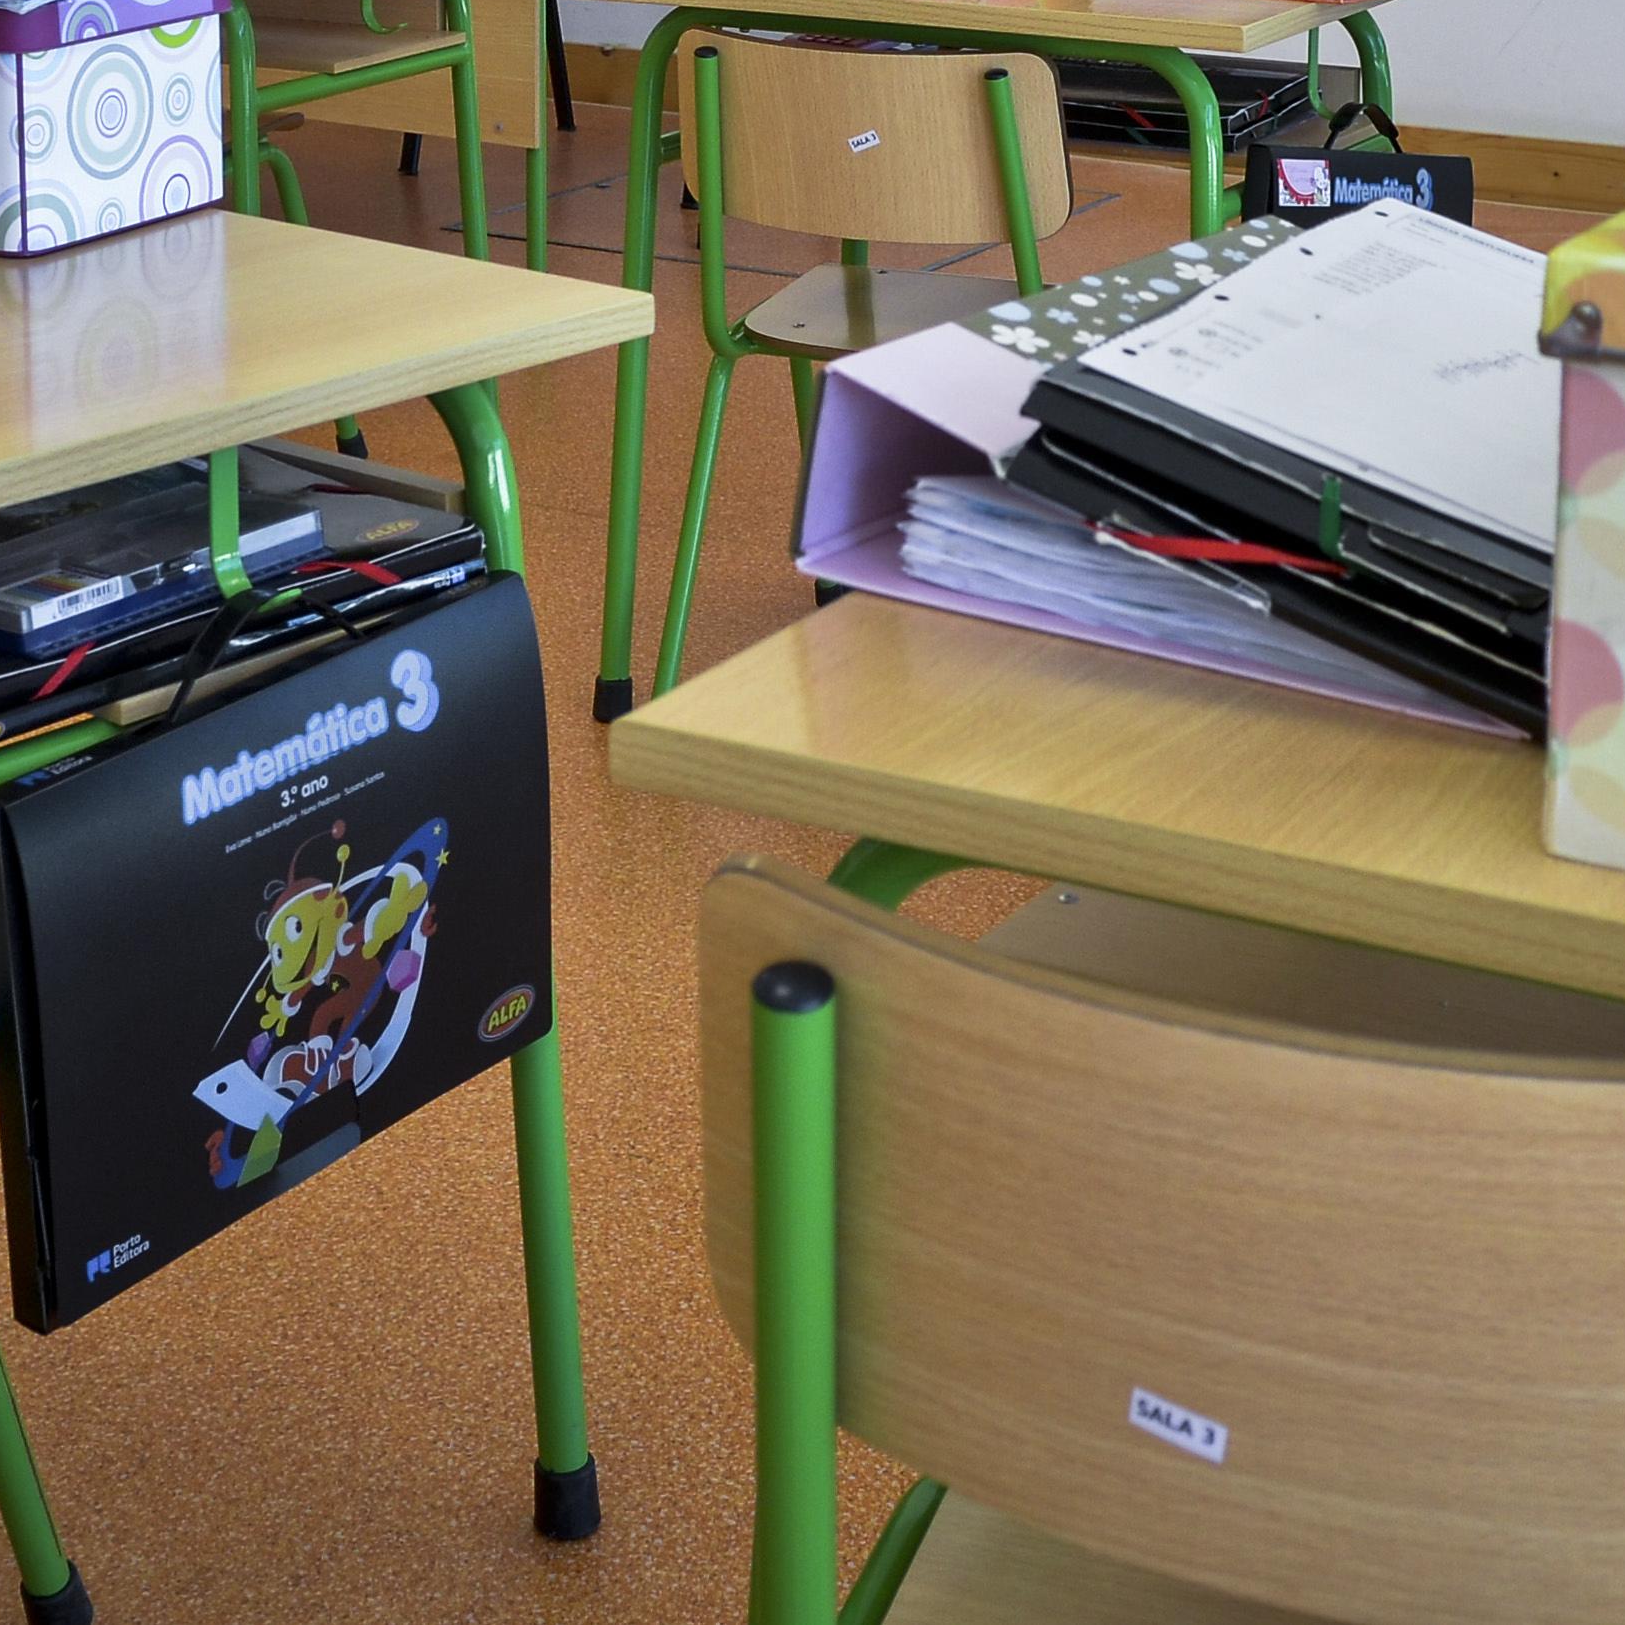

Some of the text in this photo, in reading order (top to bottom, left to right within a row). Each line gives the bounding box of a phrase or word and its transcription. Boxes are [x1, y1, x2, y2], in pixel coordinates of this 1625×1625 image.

[1333, 176, 1414, 204] Matemática
[1415, 167, 1434, 211] 3
[181, 649, 440, 825] Matemática 3
[301, 776, 330, 797] ano
[487, 995, 527, 1033] ALFA
[113, 1234, 141, 1257] Porto
[113, 1240, 150, 1268] Editora
[1137, 1398, 1215, 1446] SALA 3
